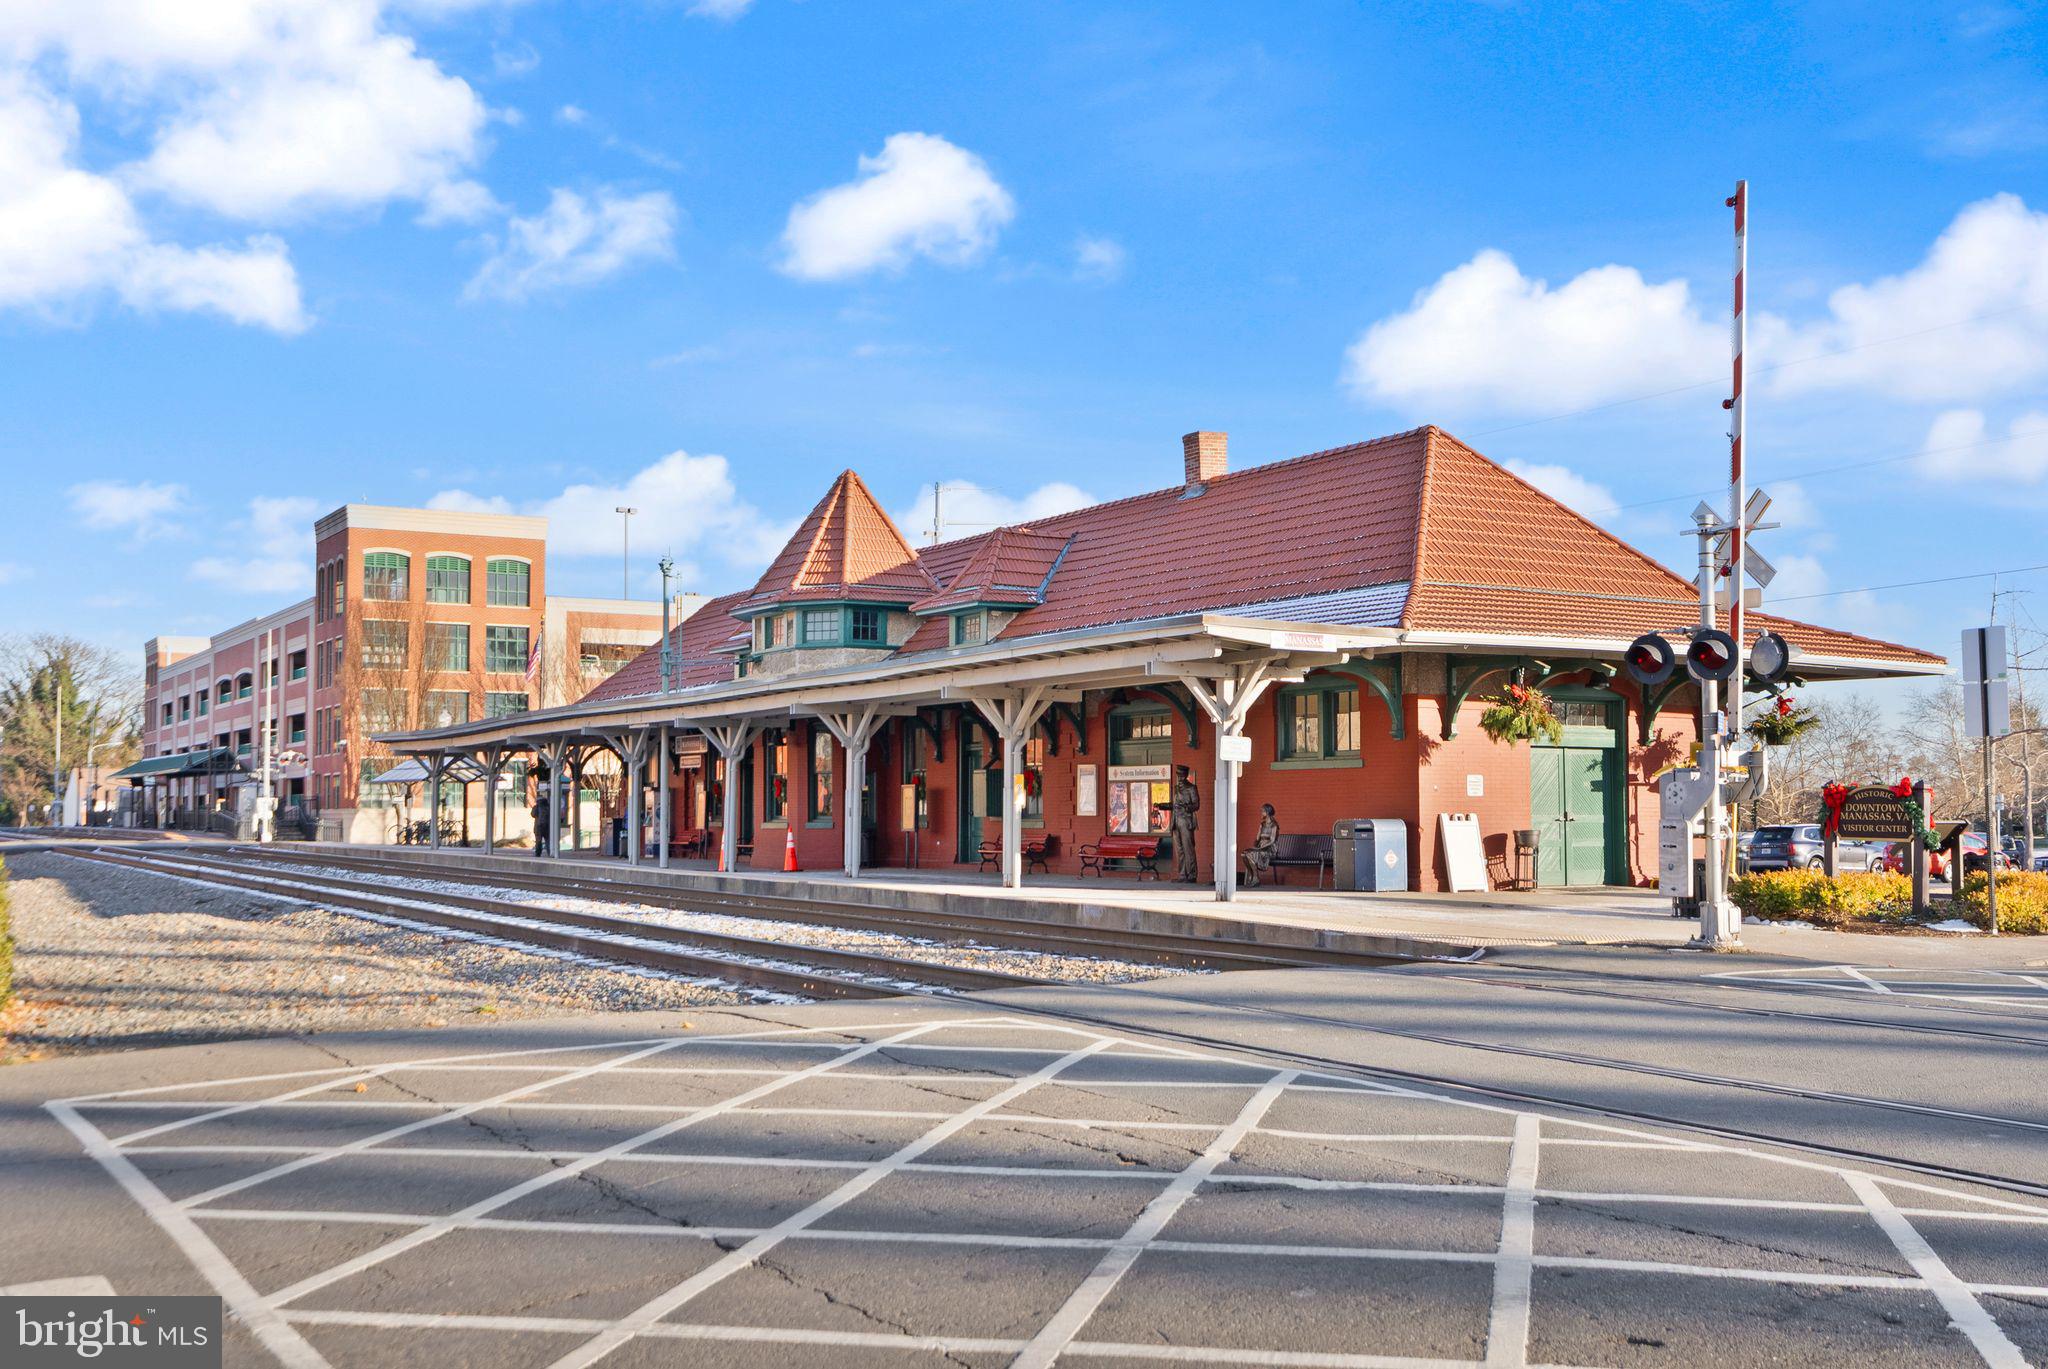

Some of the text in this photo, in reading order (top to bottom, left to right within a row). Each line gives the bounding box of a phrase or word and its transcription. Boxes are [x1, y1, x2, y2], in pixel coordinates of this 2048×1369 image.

[1854, 790, 1894, 800] HISTORIC
[1845, 803, 1904, 812] DOWNTOWN
[1840, 812, 1910, 821] MANASSAS, VA
[1843, 824, 1908, 833] VISITOR CENTER
